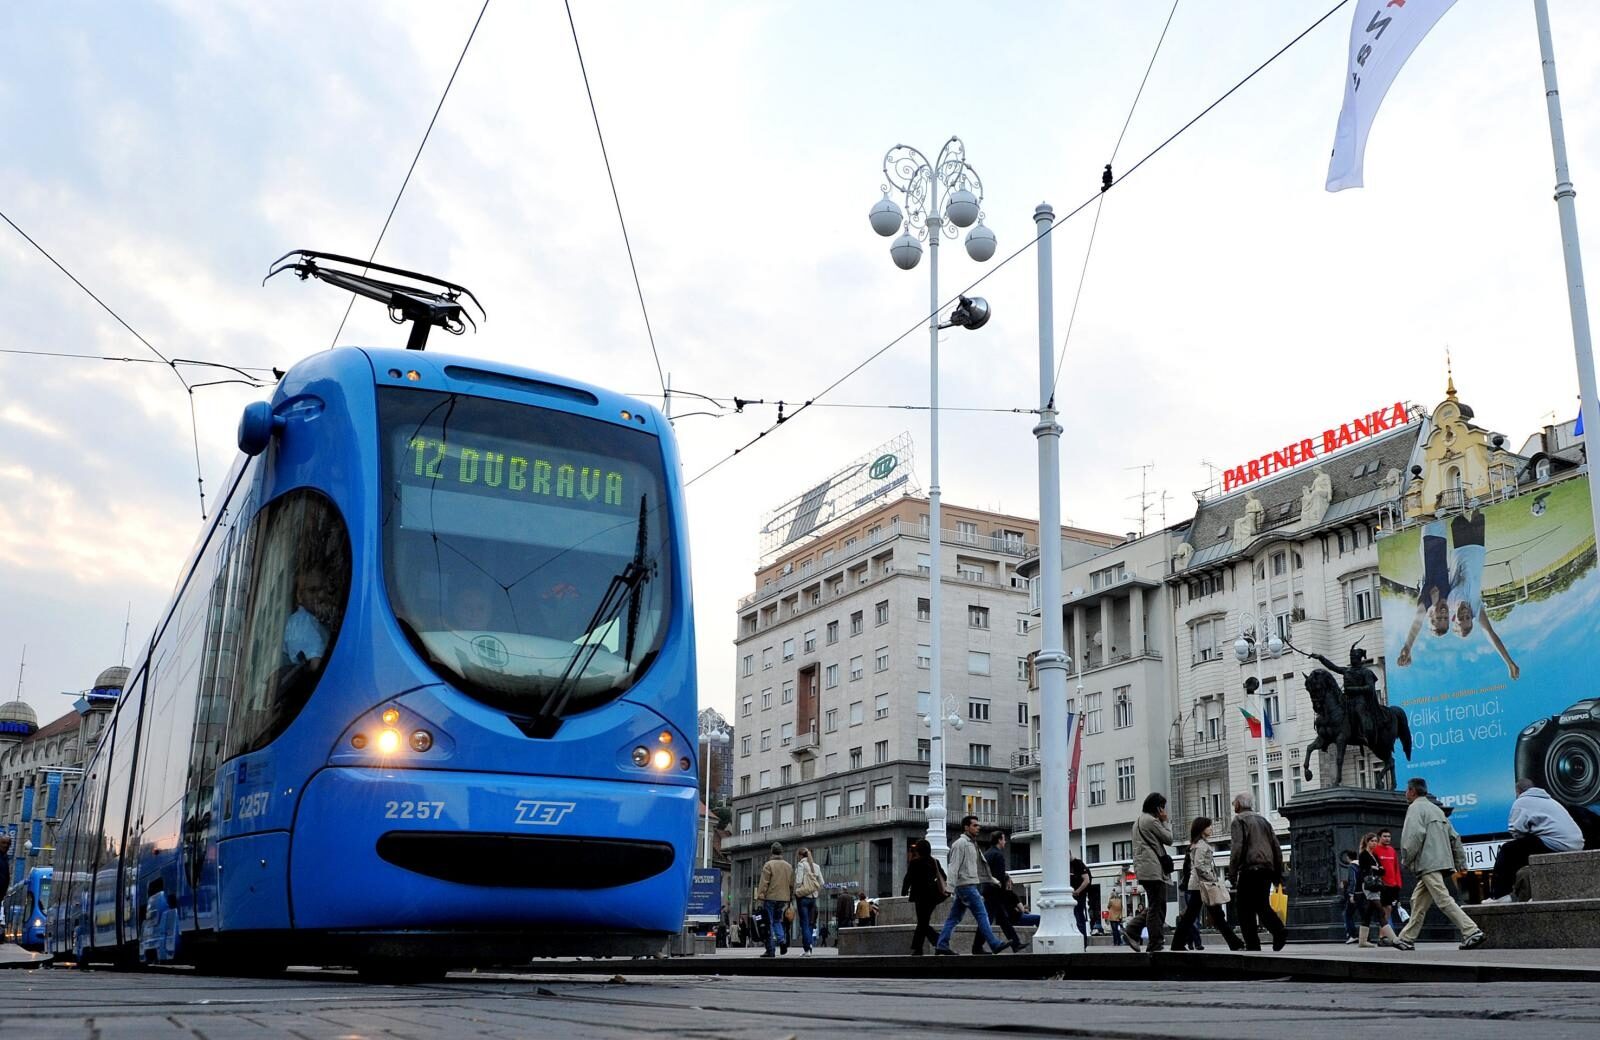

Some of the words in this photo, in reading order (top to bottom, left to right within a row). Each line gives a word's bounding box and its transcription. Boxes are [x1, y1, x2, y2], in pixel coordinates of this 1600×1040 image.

[1223, 438, 1316, 491] PARTNER
[1323, 402, 1408, 453] BANKA
[408, 439, 448, 479] 12
[459, 447, 624, 506] DUBRAVA
[1445, 696, 1504, 722] trenuci.
[1429, 727, 1464, 750] puta
[1468, 719, 1507, 741] veći.
[238, 791, 270, 819] 2257
[384, 801, 445, 819] 2257
[514, 800, 577, 825] ZET
[1466, 847, 1484, 867] ija
